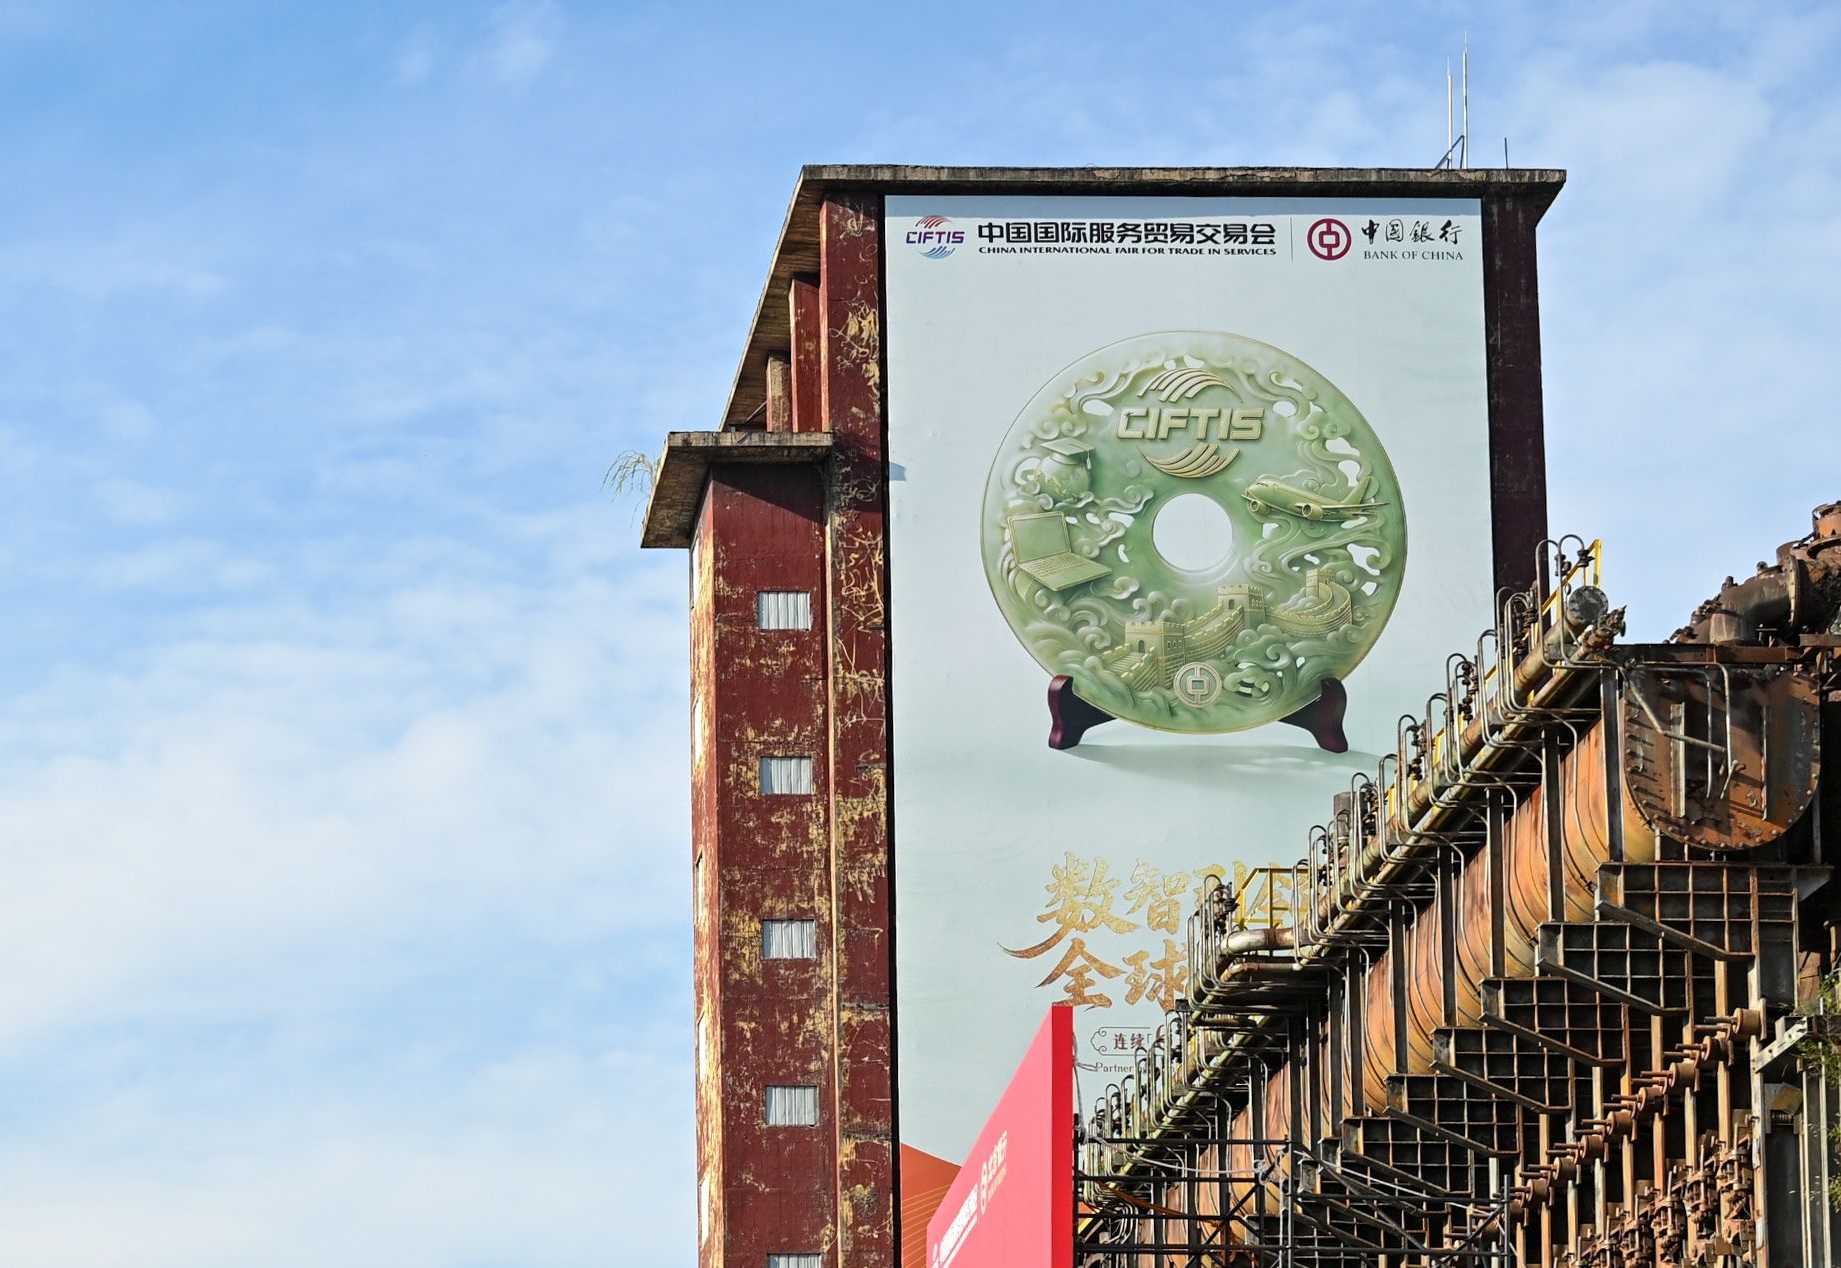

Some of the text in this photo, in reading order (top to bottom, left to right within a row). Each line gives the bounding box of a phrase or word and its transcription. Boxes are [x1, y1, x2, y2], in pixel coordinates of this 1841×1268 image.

[906, 231, 965, 244] CIFTIS
[978, 222, 1277, 245] 中国国际服务贸易交易会
[979, 246, 1017, 254] CHINA
[1019, 246, 1112, 255] INTERNATIONAL
[1115, 247, 1139, 255] FAIR
[1142, 247, 1165, 255] FOR
[1224, 248, 1277, 256] SERVICES
[1364, 250, 1464, 261] BANK OF CHINA
[1116, 405, 1265, 441] CIFTIS
[1095, 1061, 1134, 1073] Partner
